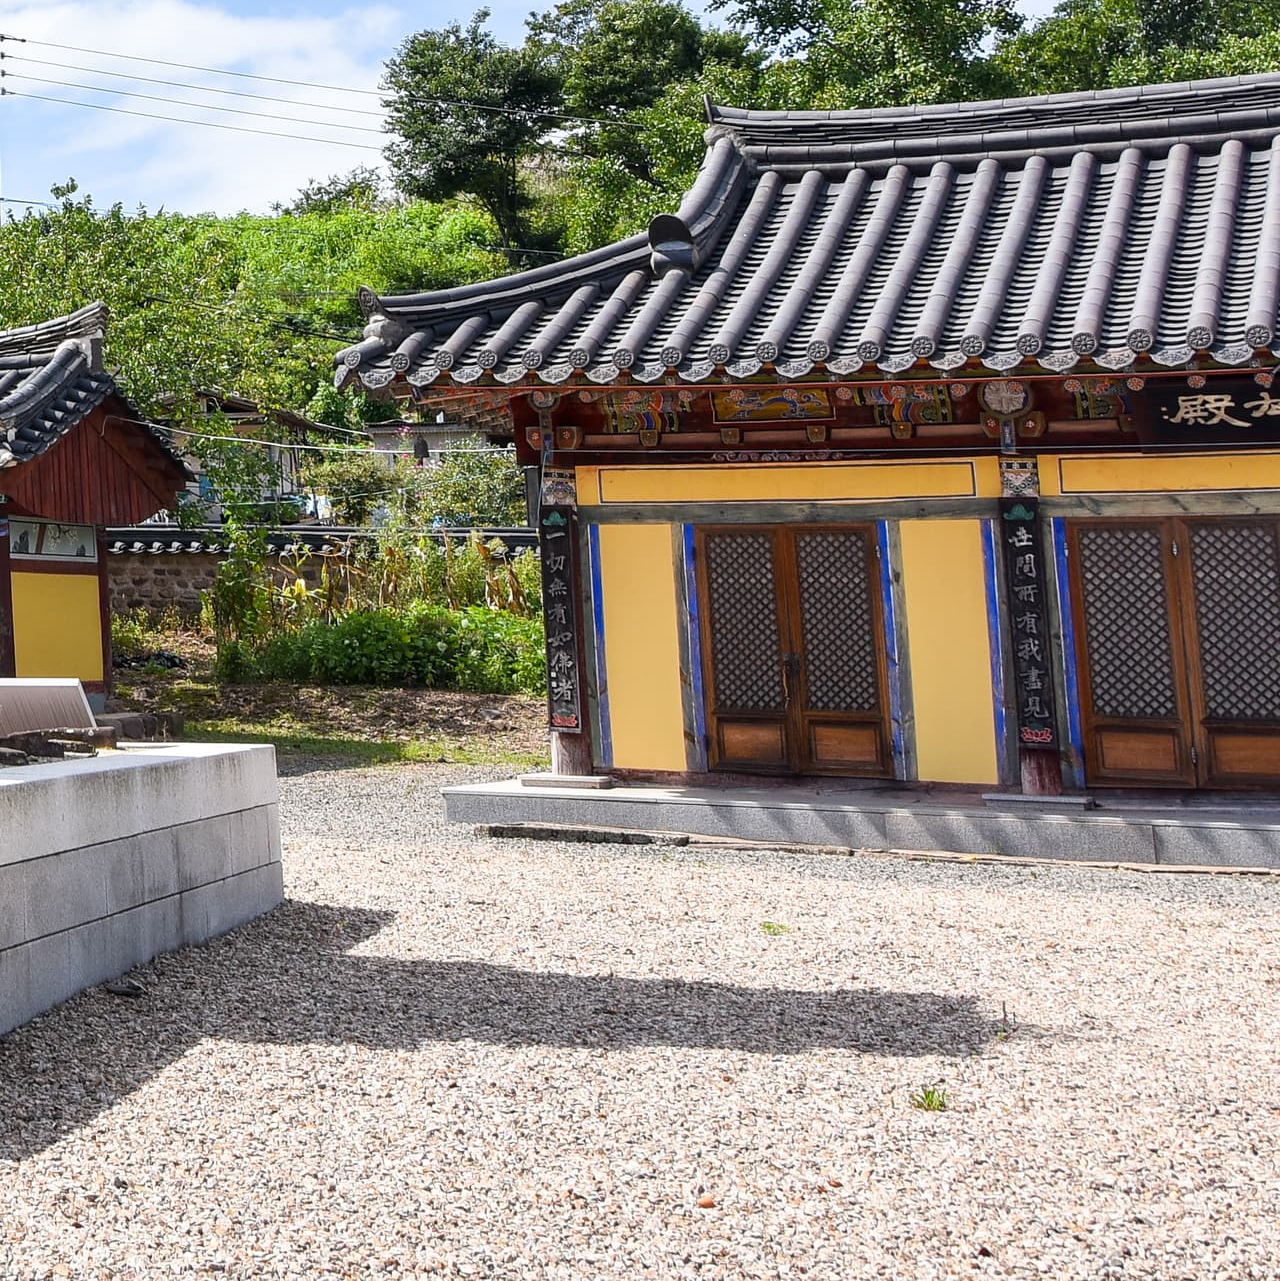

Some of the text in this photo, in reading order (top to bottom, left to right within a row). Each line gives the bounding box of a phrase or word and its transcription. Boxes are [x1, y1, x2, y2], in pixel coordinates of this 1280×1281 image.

[1008, 526, 1050, 719] 世間所有我盡見
